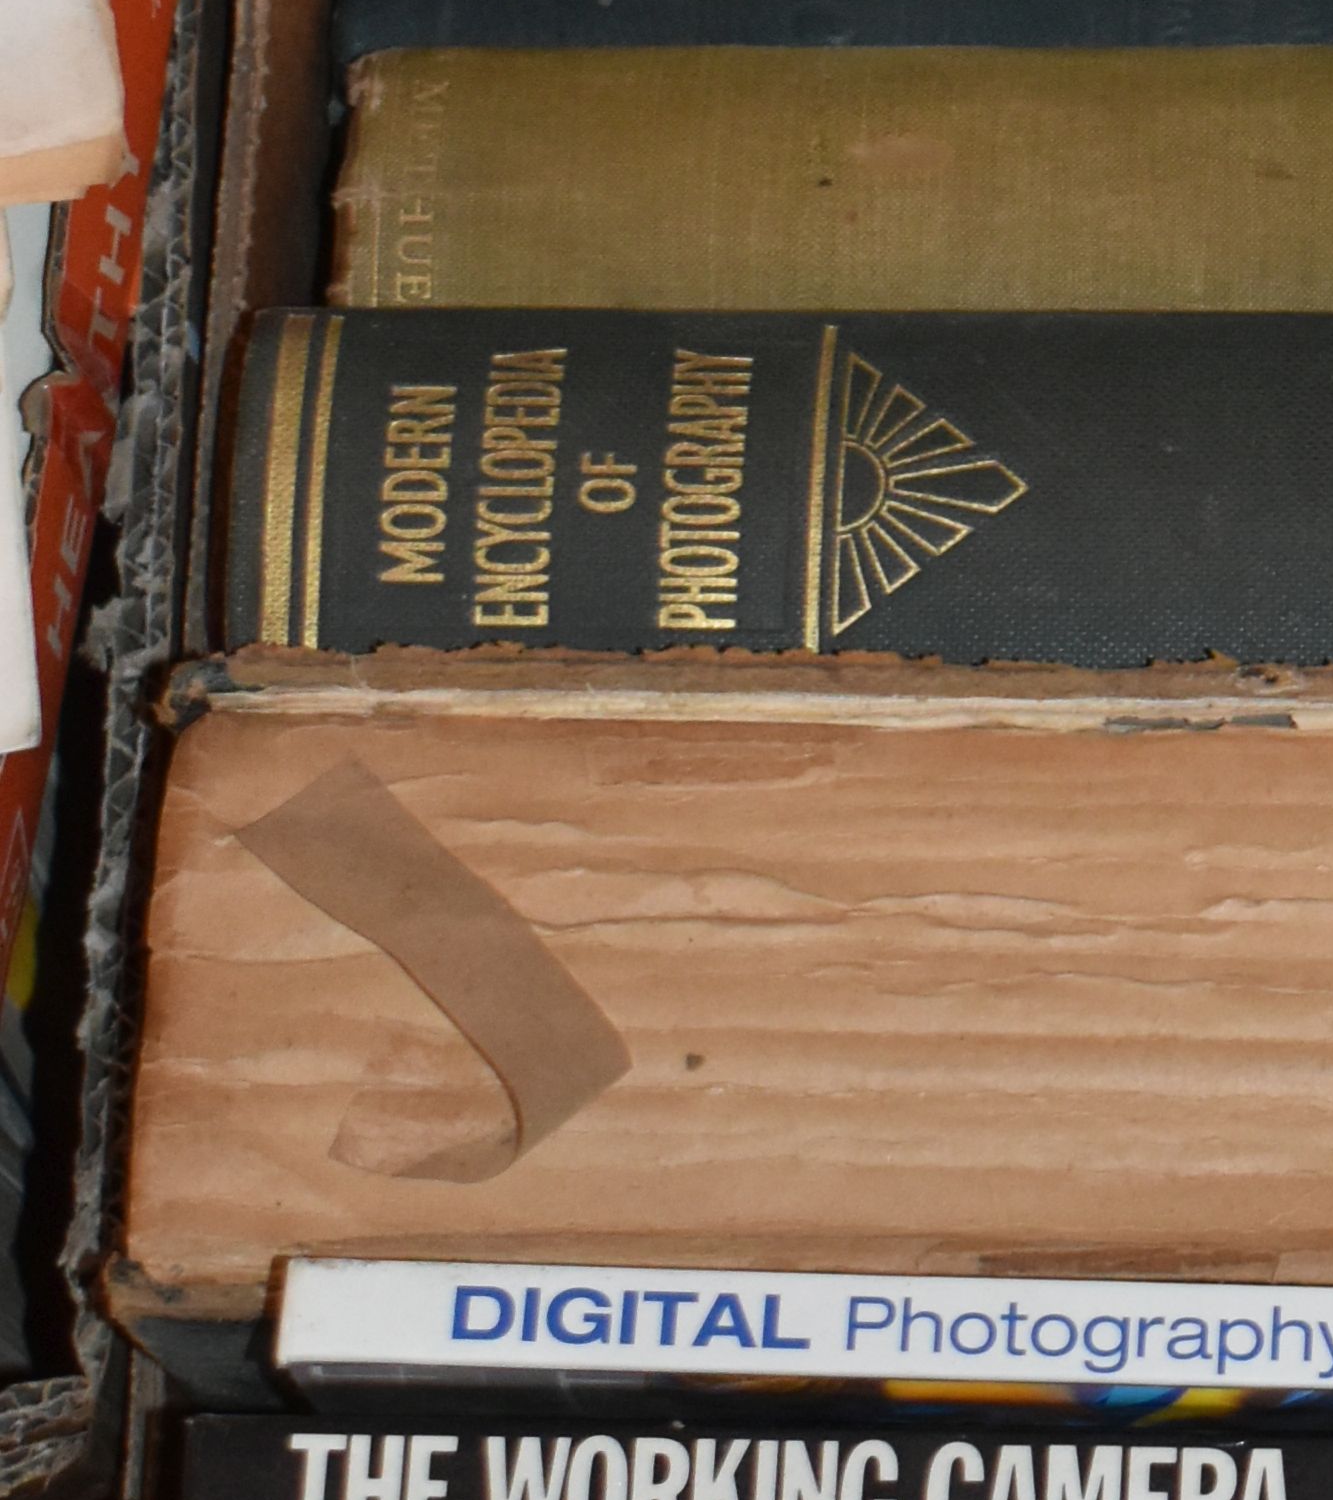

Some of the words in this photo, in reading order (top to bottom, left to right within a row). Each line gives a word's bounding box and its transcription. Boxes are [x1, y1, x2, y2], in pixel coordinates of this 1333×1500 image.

[377, 383, 458, 585] MODERN
[472, 346, 569, 629] ENCYCLOPEDIA
[577, 451, 638, 515] OF
[657, 347, 755, 631] PHOTOGRAPHY
[450, 1283, 811, 1352] DIGITAL
